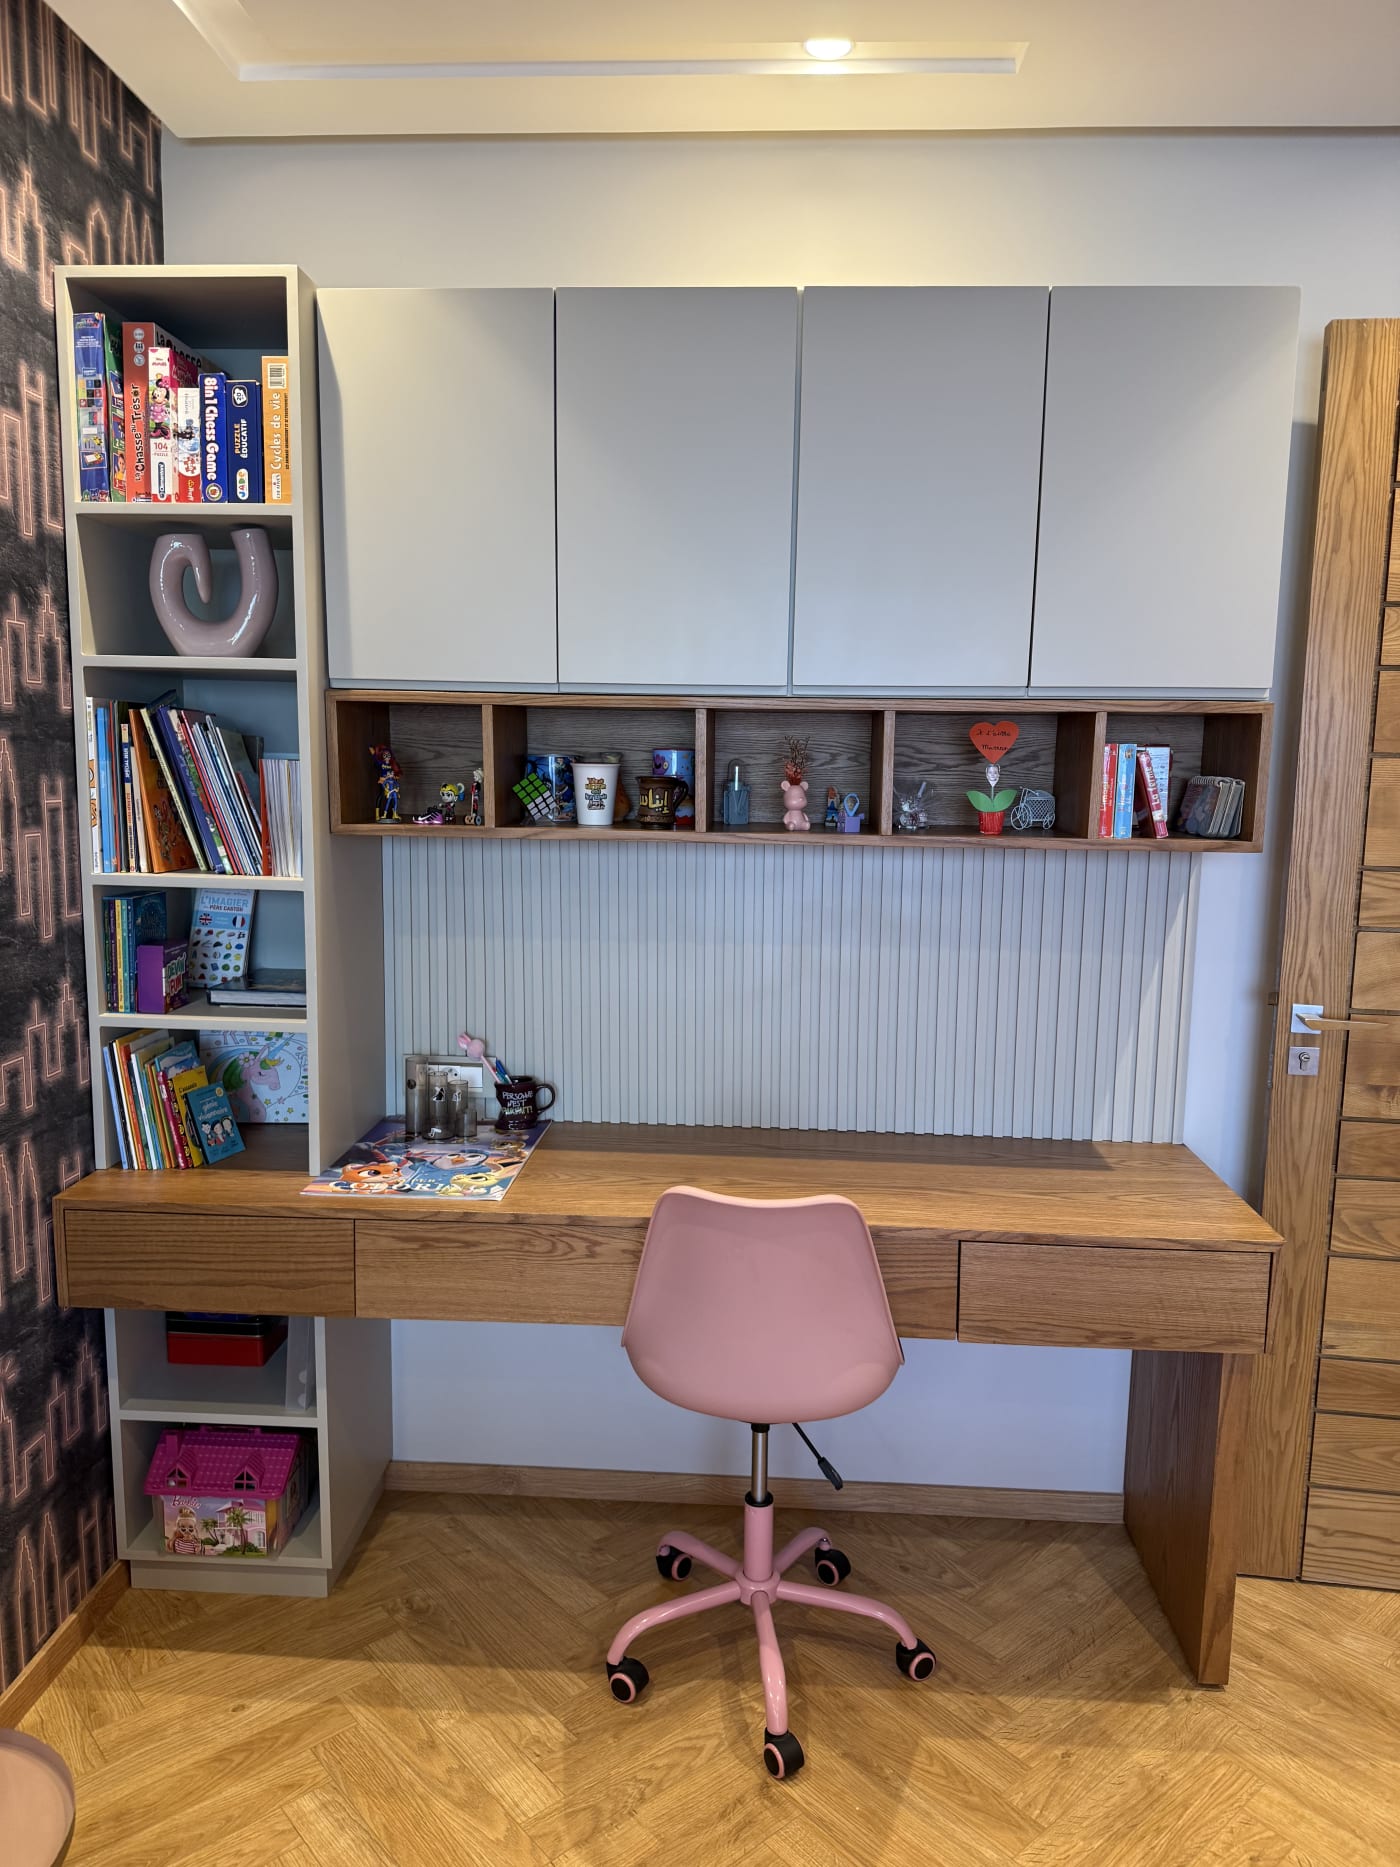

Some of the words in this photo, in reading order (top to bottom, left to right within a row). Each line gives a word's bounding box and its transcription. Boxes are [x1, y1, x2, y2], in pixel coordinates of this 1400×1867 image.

[269, 392, 281, 410] vie
[131, 424, 137, 433] au
[205, 406, 219, 441] Chess
[270, 414, 281, 429] de
[154, 442, 168, 451] 104
[240, 418, 248, 459] ÉDUCATIF
[270, 433, 283, 470] Cycles
[134, 432, 145, 474] Chasse
[206, 442, 220, 481] Game
[1145, 766, 1157, 793] ferme
[1151, 793, 1160, 805] La
